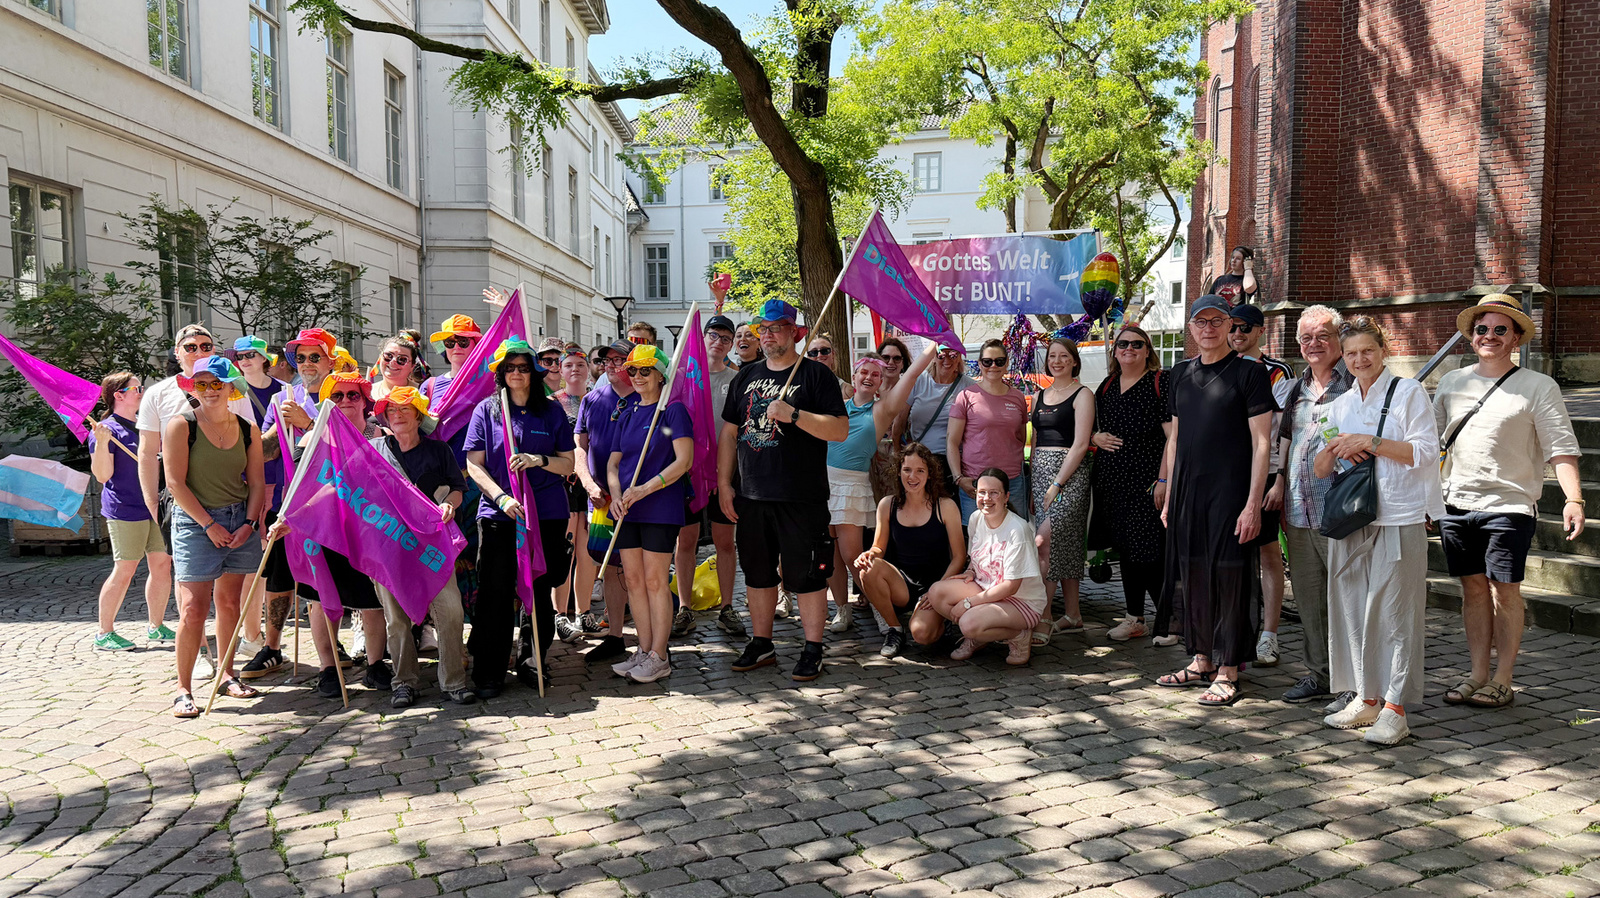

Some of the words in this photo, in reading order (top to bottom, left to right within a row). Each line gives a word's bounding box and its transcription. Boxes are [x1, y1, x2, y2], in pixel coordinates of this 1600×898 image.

[922, 252, 991, 272] Gottes
[996, 248, 1051, 271] Welt
[934, 281, 963, 302] ist
[970, 281, 1031, 302] BUNT!
[744, 378, 776, 394] BILLY
[316, 458, 419, 551] Diakonie
